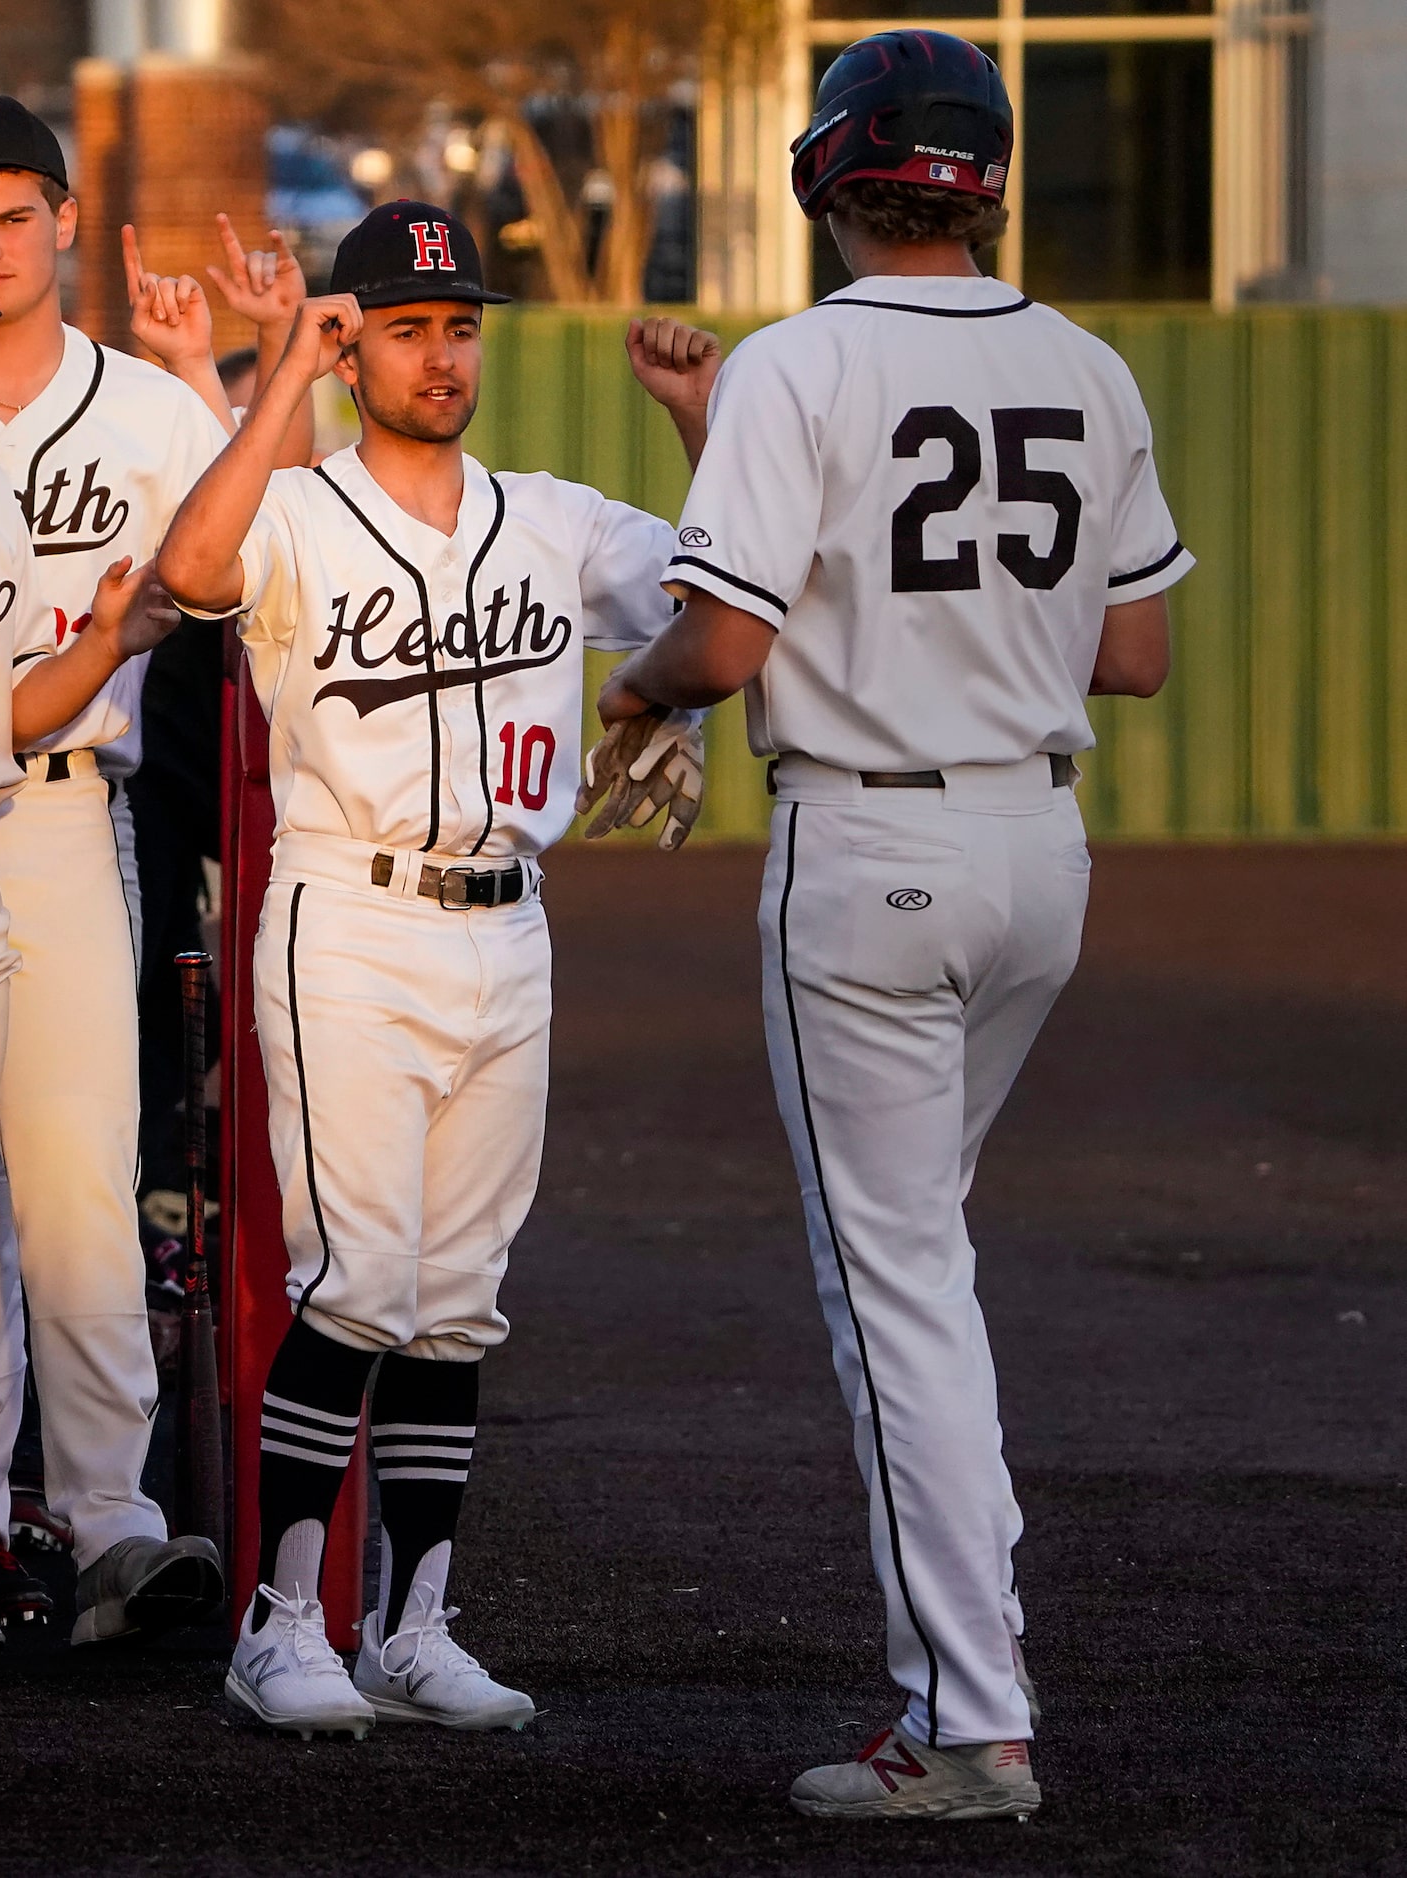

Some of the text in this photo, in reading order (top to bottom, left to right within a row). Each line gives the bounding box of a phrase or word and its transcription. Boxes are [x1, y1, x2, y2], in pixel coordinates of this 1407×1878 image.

[914, 144, 975, 161] RAWLINGS
[408, 221, 457, 272] H
[891, 405, 1085, 593] 25
[313, 574, 573, 676] Heath
[494, 721, 556, 812] 10
